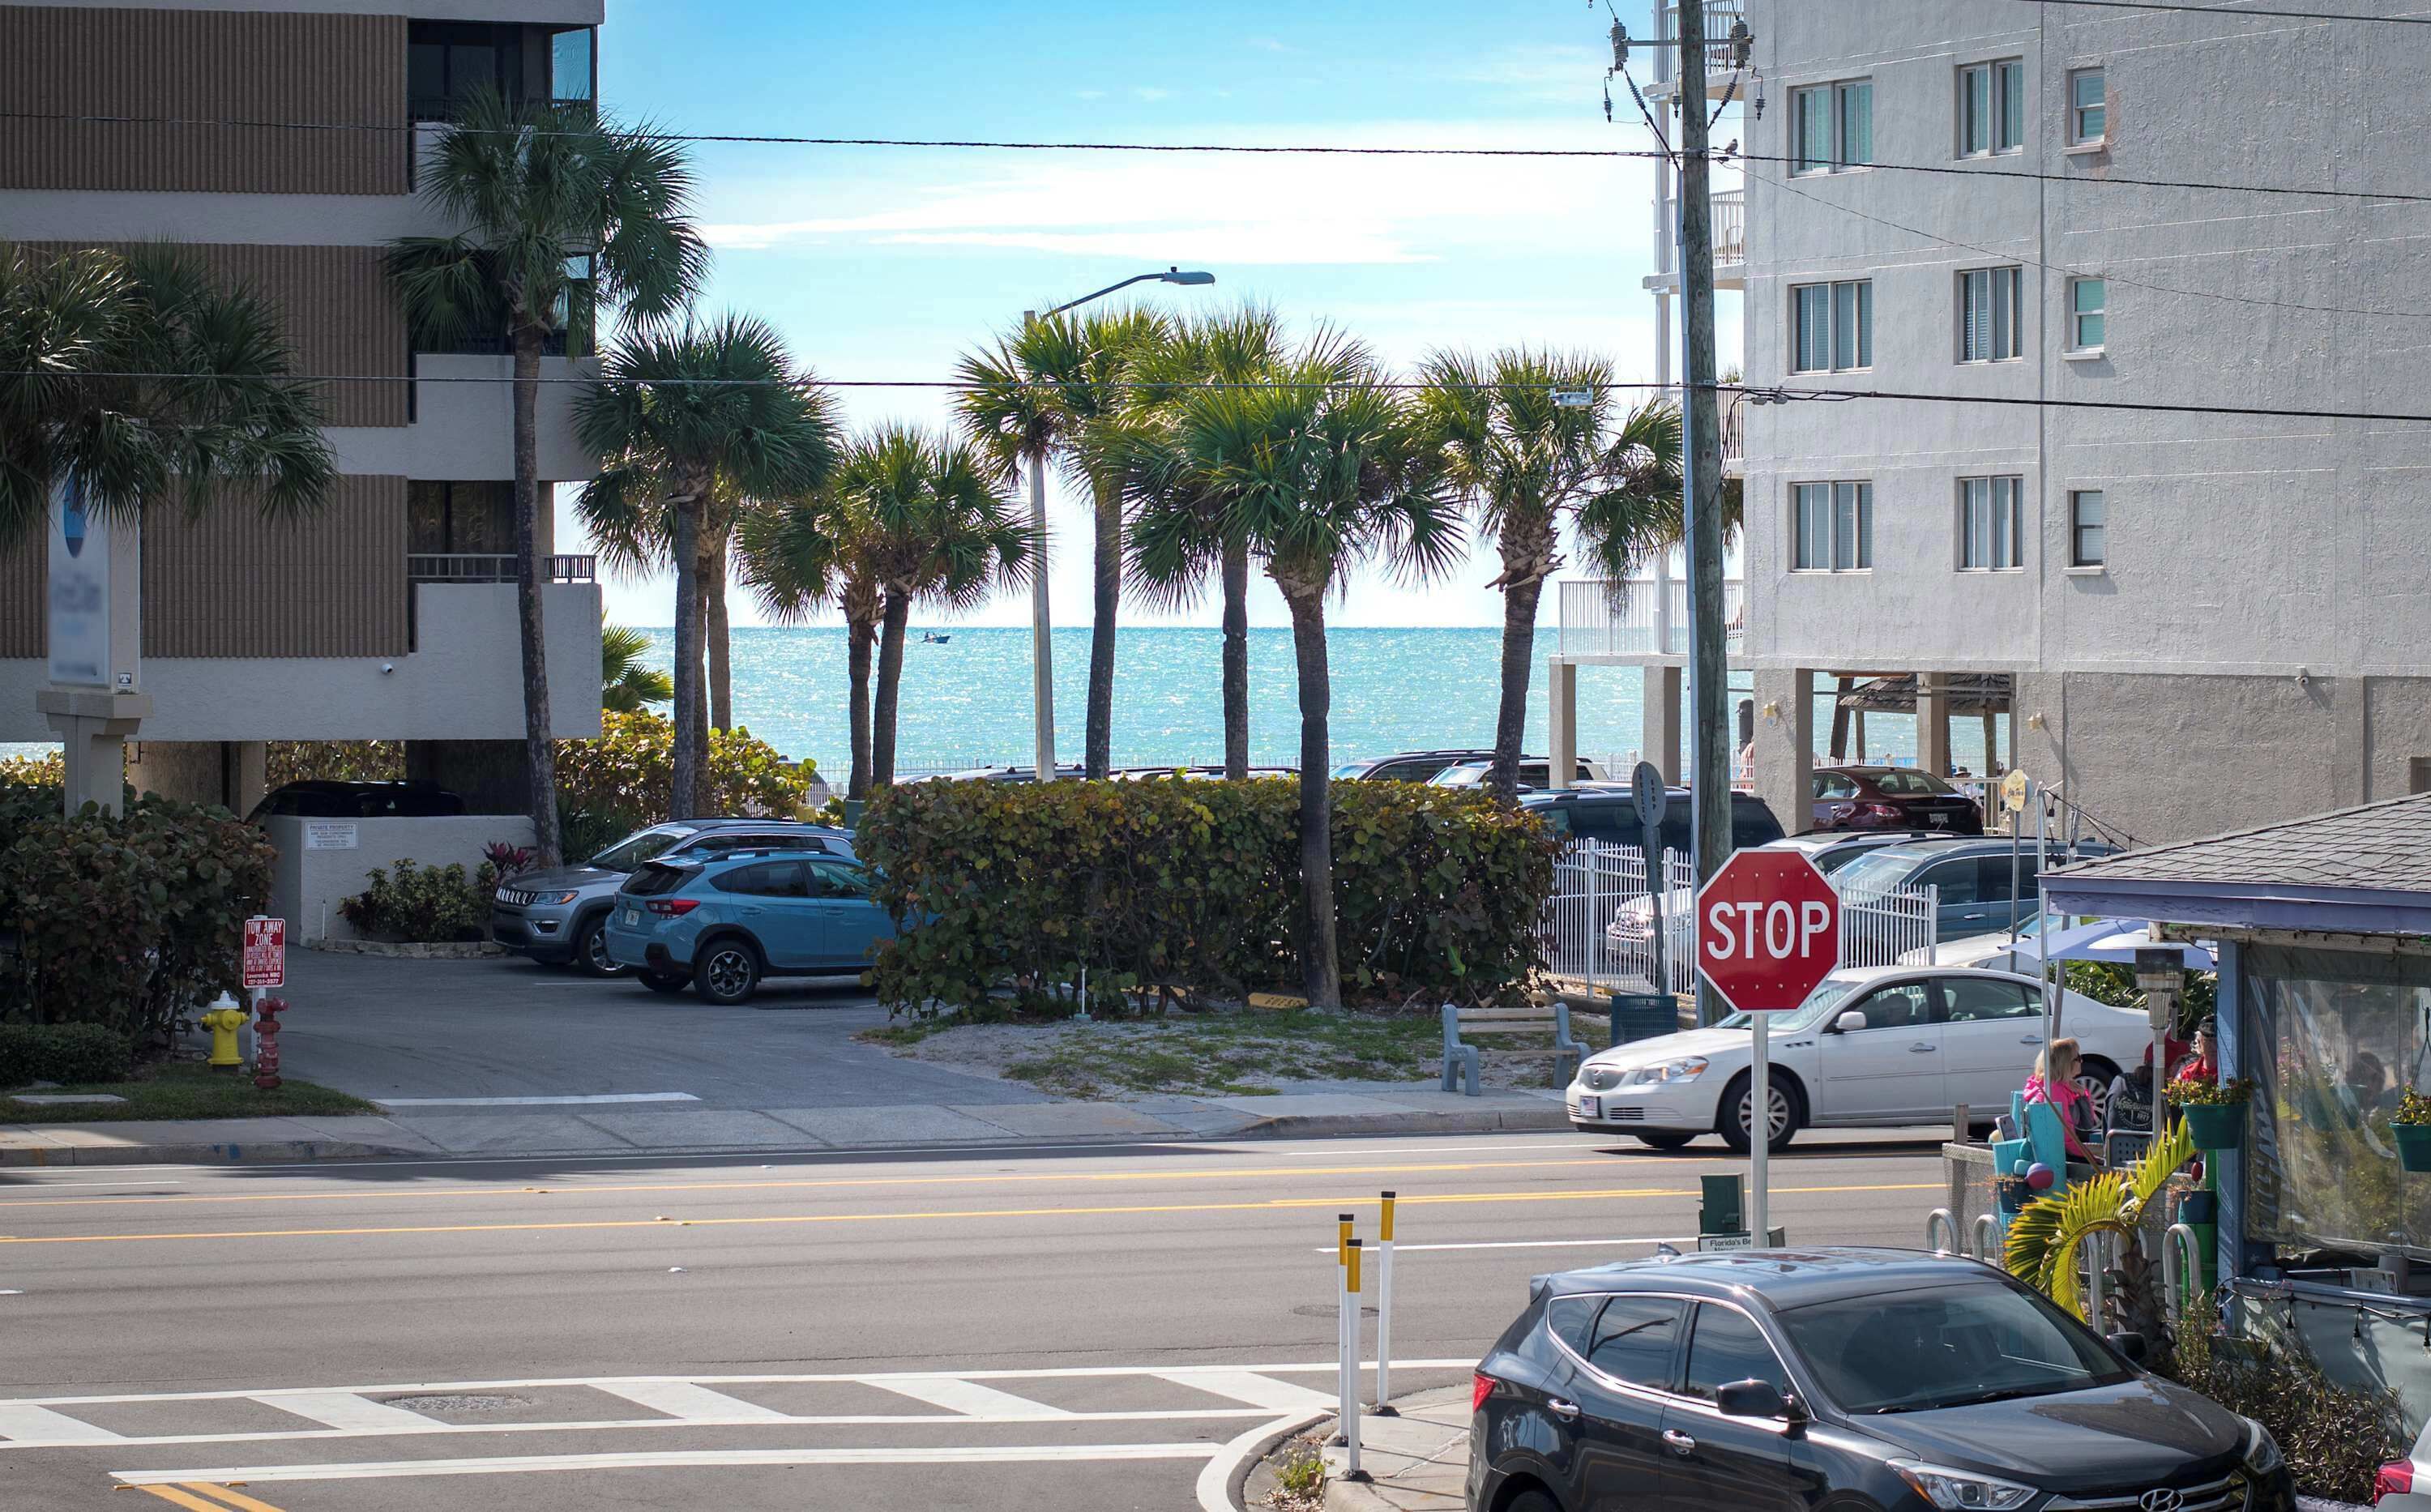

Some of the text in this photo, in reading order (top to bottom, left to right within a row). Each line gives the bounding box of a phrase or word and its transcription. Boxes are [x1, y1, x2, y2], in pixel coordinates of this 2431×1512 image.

[248, 920, 283, 934] TOW AWAY
[1707, 900, 1831, 959] STOP
[255, 933, 273, 946] ZONE
[1710, 1238, 1741, 1247] Florida's
